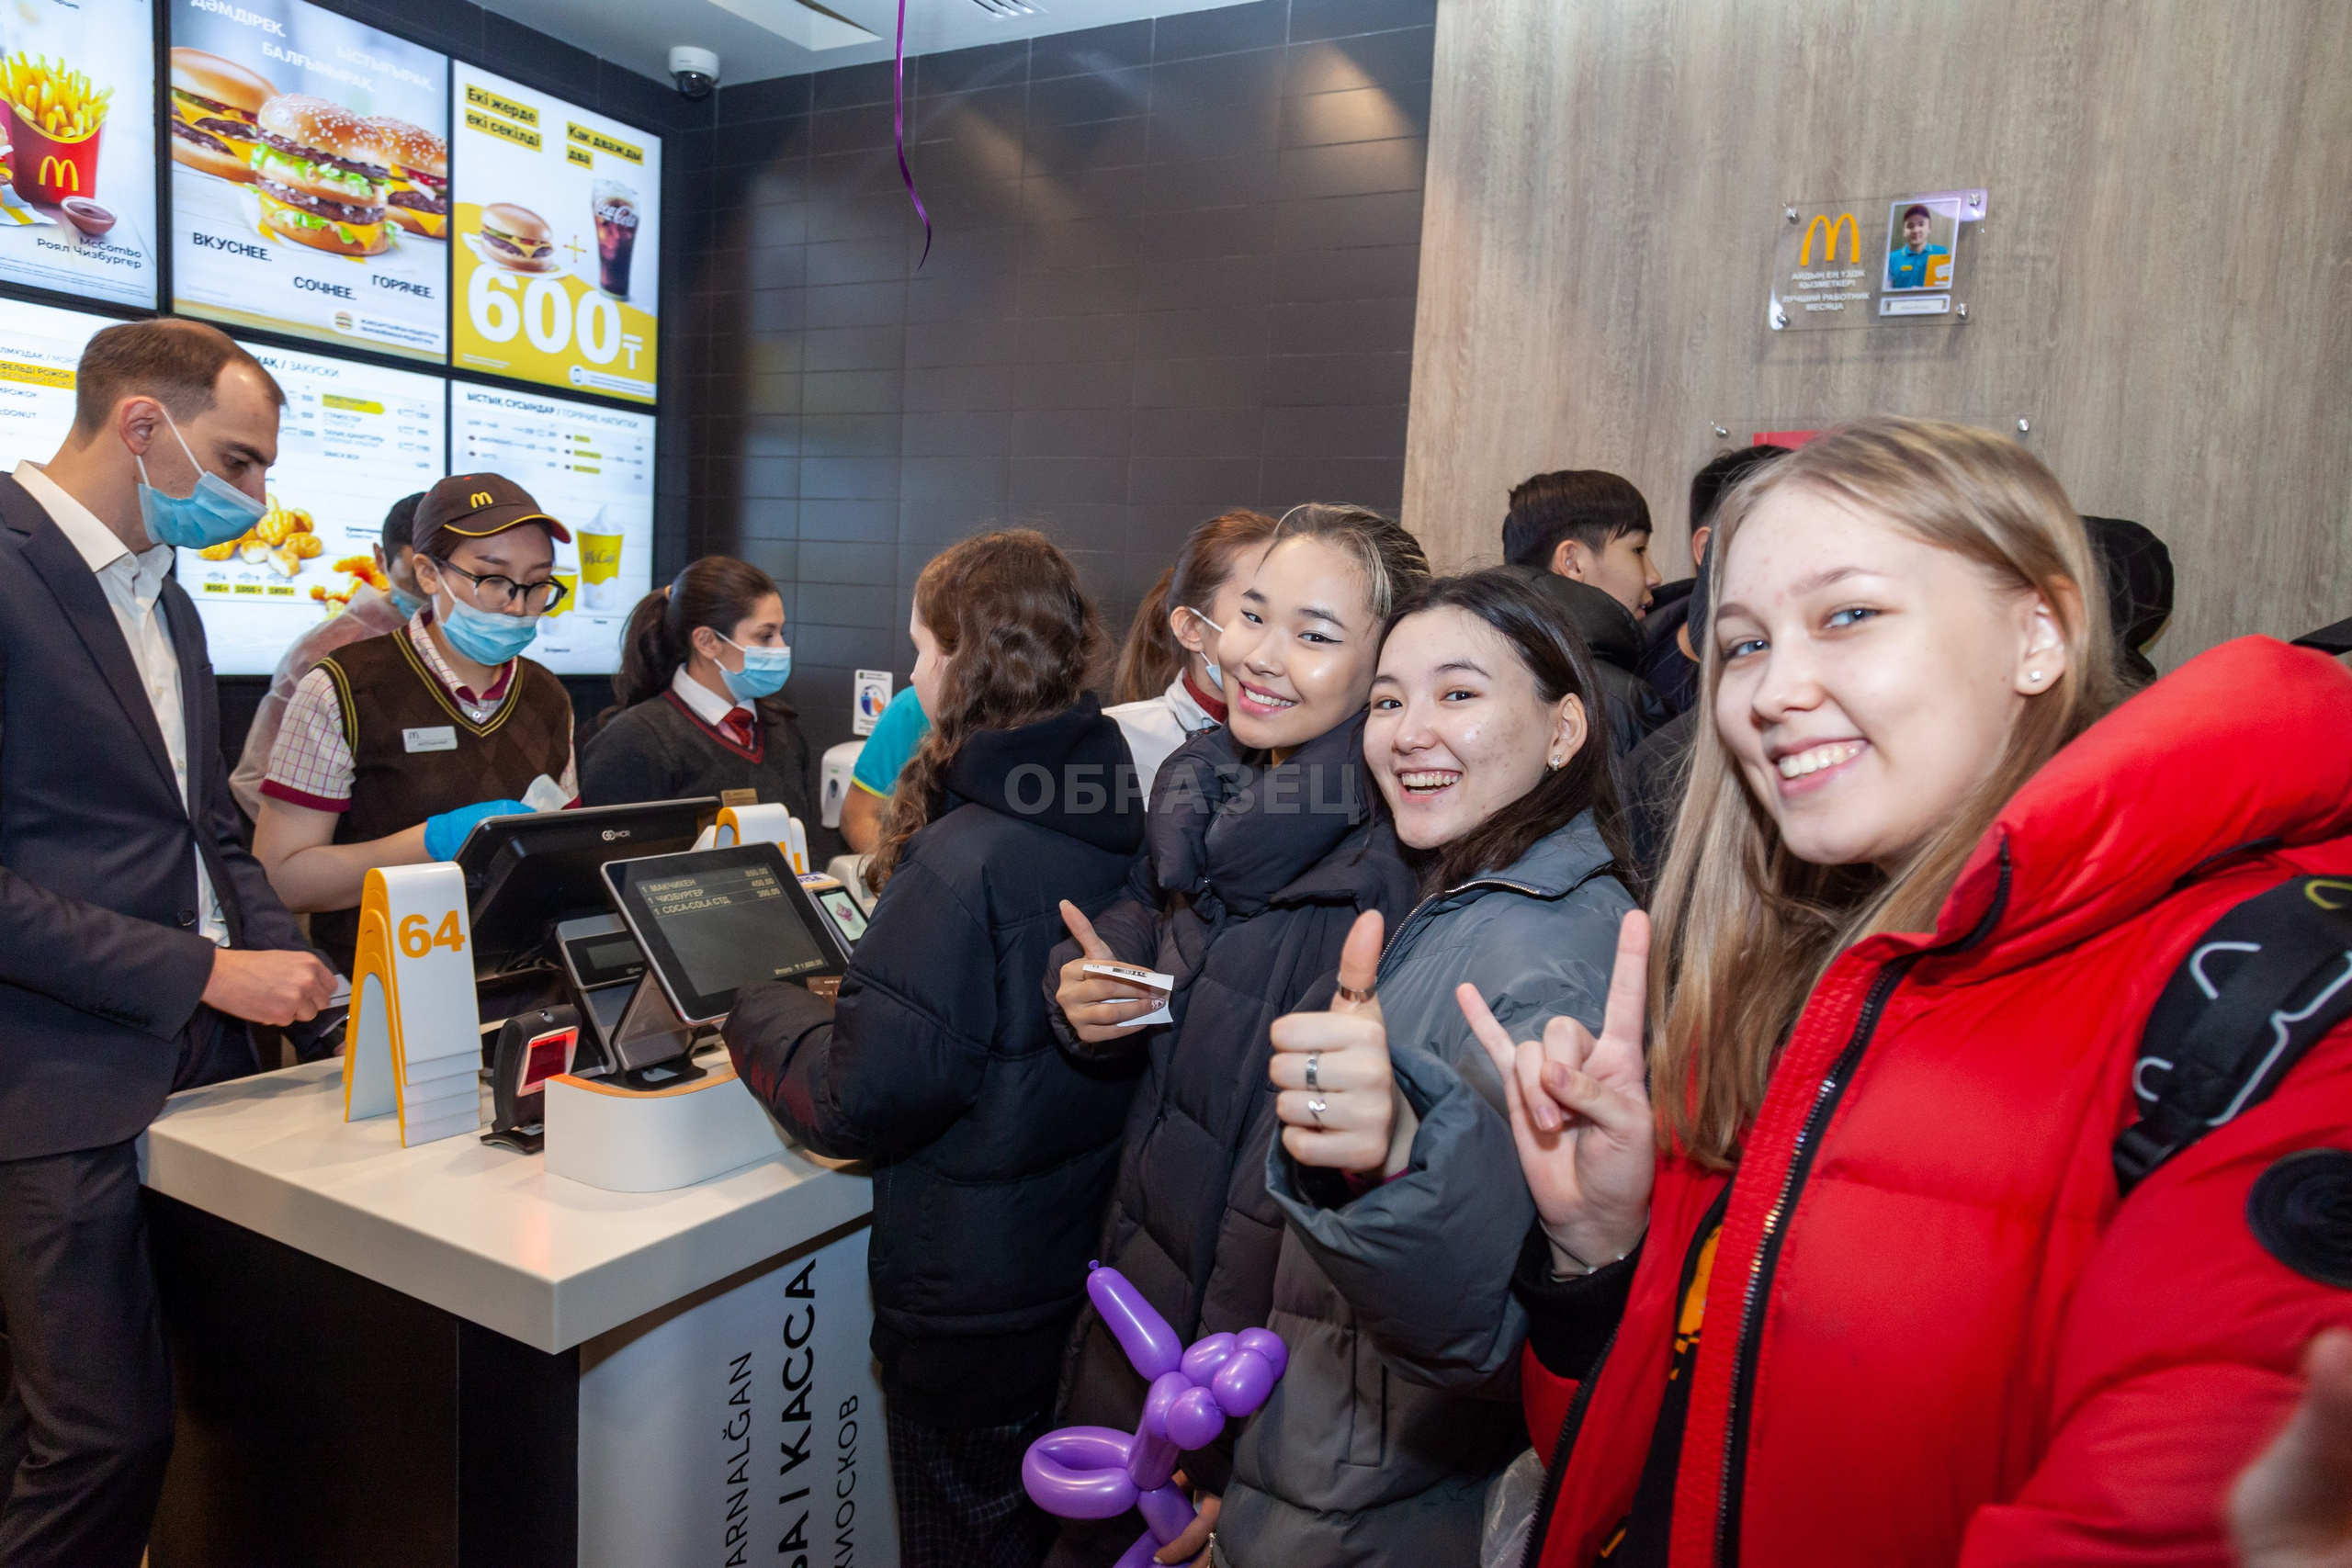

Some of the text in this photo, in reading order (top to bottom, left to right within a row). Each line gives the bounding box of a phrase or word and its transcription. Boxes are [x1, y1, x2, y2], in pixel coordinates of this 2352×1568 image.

[468, 87, 536, 123] Екі жерде
[468, 112, 540, 147] екі секілді
[568, 126, 642, 161] Как дважды
[569, 149, 591, 165] два
[38, 238, 141, 268] Роял Чизбургер
[80, 237, 141, 258] McCombo
[193, 232, 273, 262] ВКУСНЕЕ.
[294, 276, 356, 301] СОЧНЕЕ.
[372, 275, 435, 299] ГОРЯЧЕЕ.
[1822, 292, 1871, 302] РАБОТНИК
[1805, 302, 1844, 311] МЕСЯЦА
[290, 361, 339, 378] ЗАКУСКИ
[650, 879, 696, 892] МАКЧИКЕН
[656, 889, 704, 902] ЧИЗБУРГЕР
[398, 909, 466, 959] 64
[781, 1258, 817, 1476] КАССА
